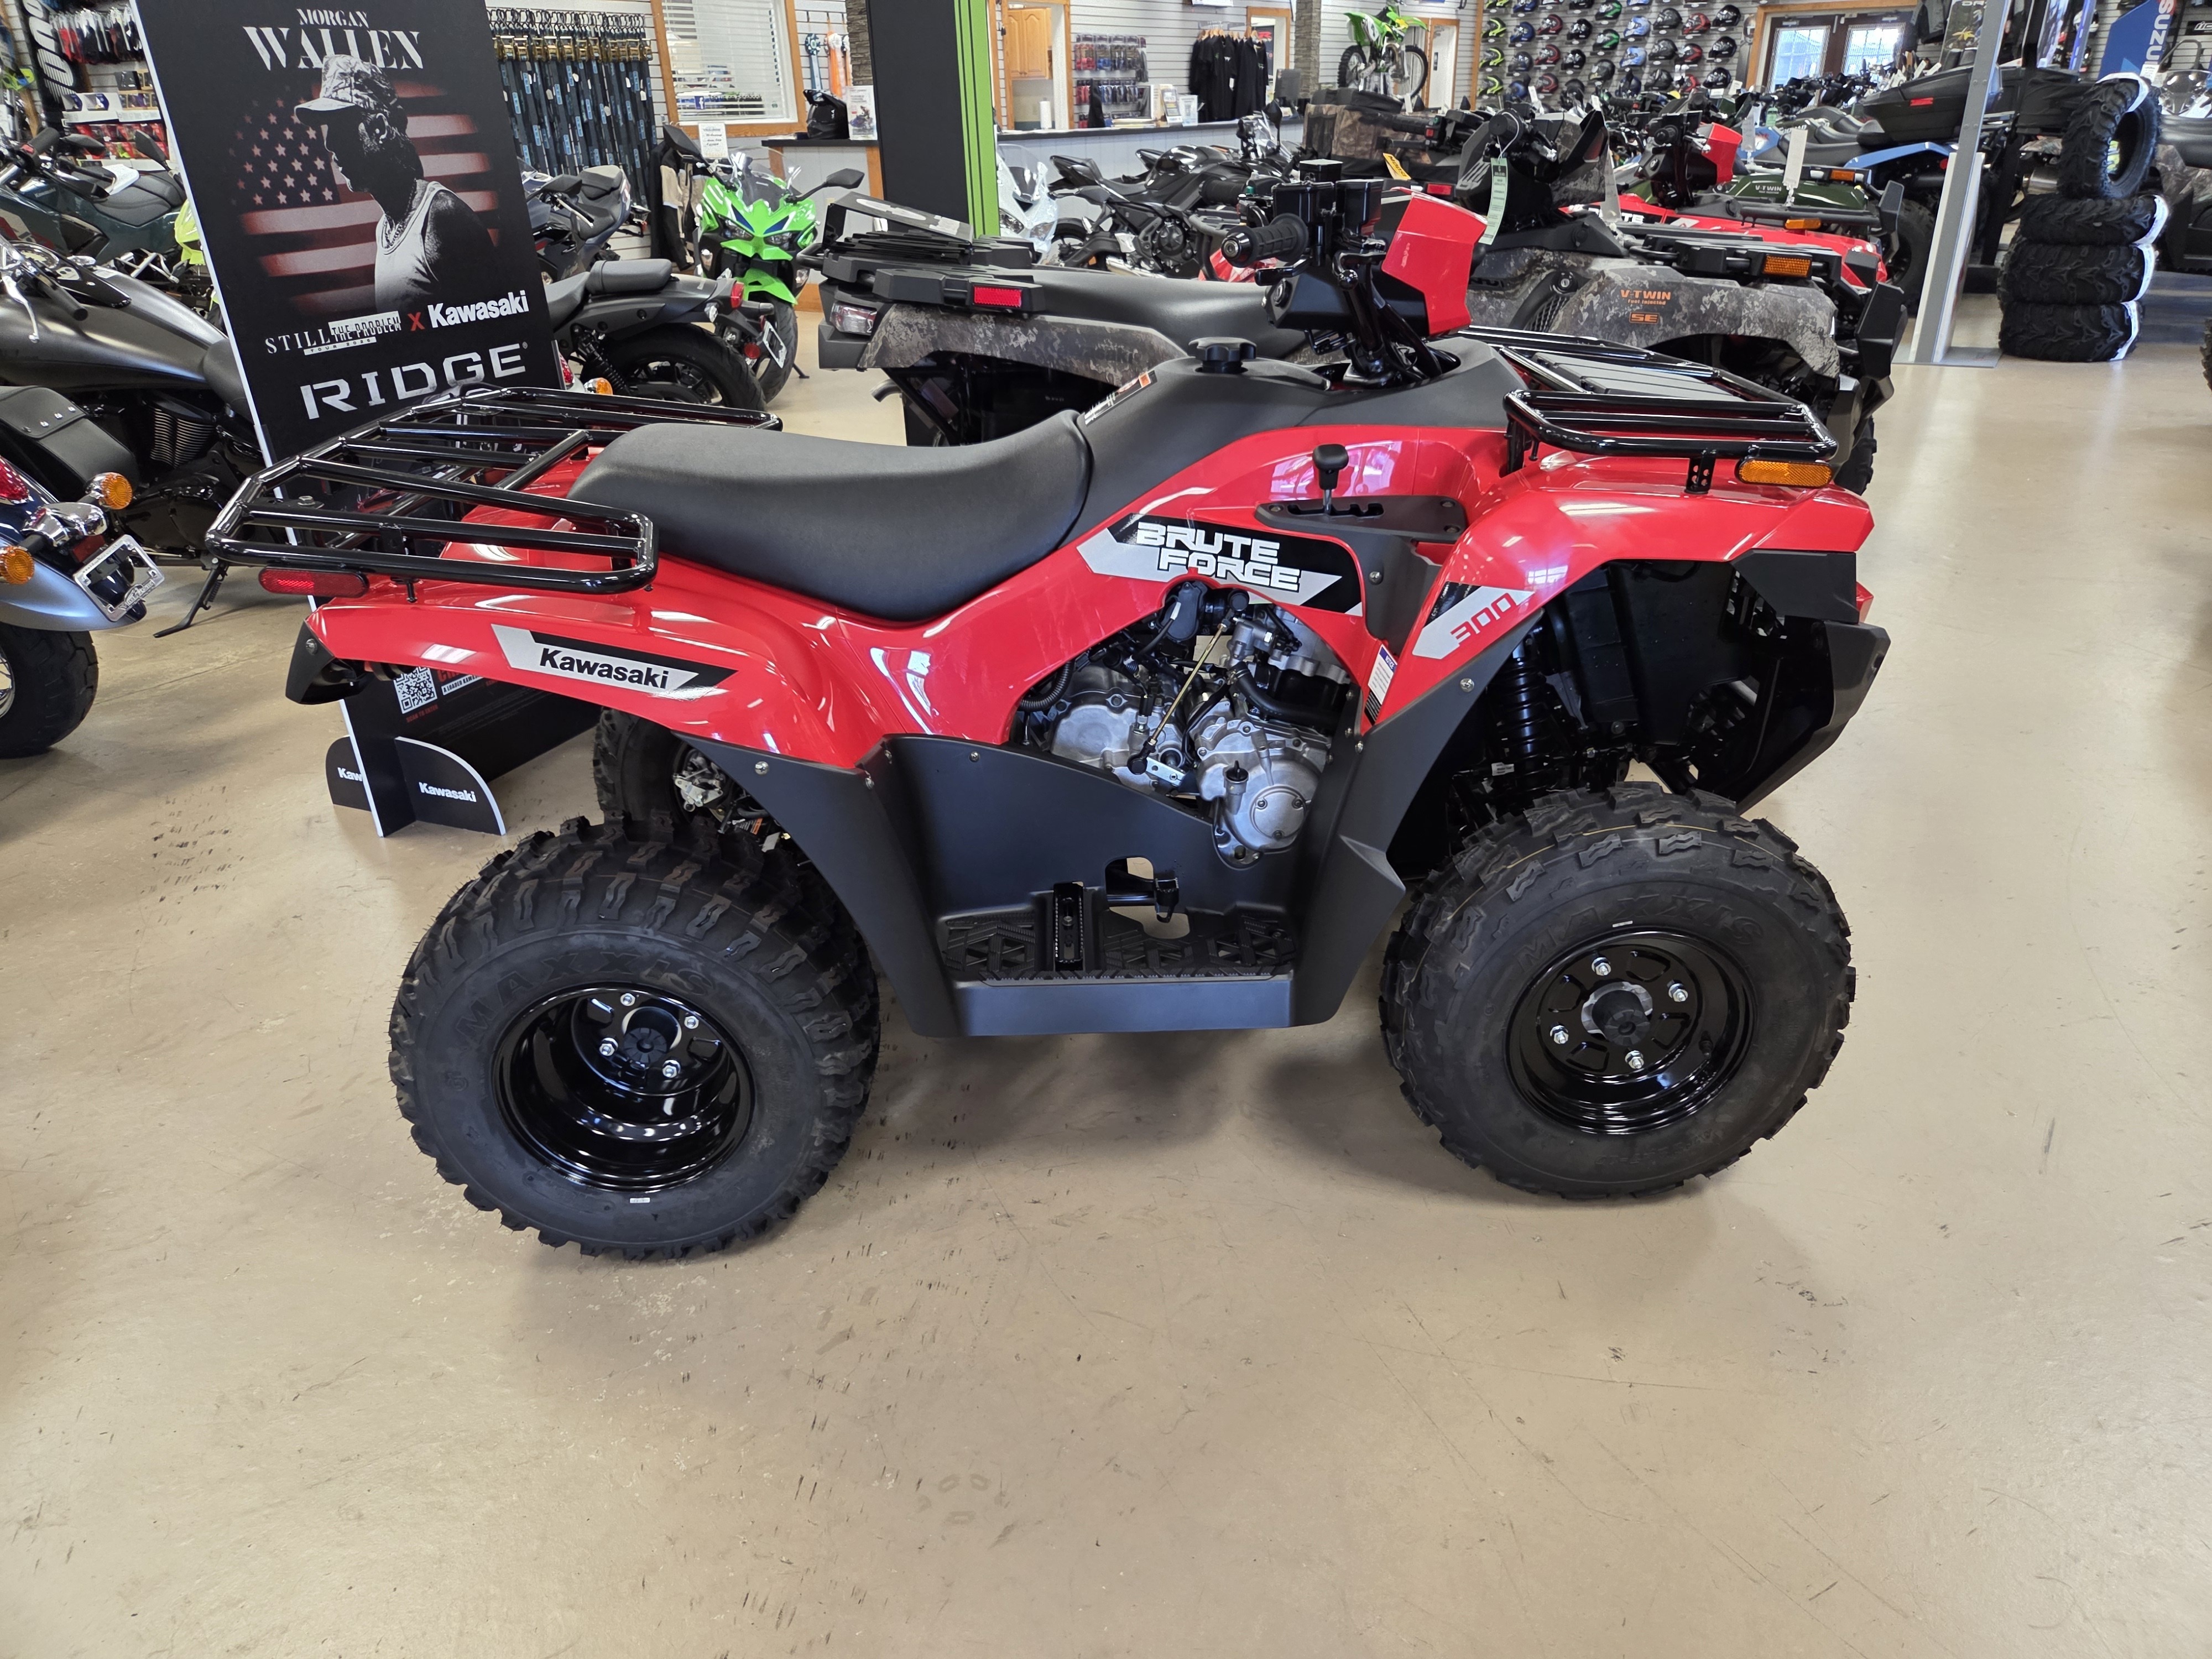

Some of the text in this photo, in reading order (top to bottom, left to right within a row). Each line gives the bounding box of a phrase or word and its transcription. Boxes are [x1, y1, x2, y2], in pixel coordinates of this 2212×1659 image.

[296, 8, 369, 28] MORGAN
[1620, 289, 1671, 300] V-TWIN
[265, 328, 331, 354] STILL
[427, 290, 529, 328] Kawasaki
[1631, 314, 1658, 322] SE
[310, 337, 372, 353] TOUR 2026
[1136, 521, 1280, 565] BRUTE
[1159, 548, 1300, 591] FORCE
[1450, 593, 1517, 645] 300
[540, 648, 669, 689] Kawasaki
[419, 782, 477, 802] Kawasaki
[456, 950, 716, 1042] MAXXIS
